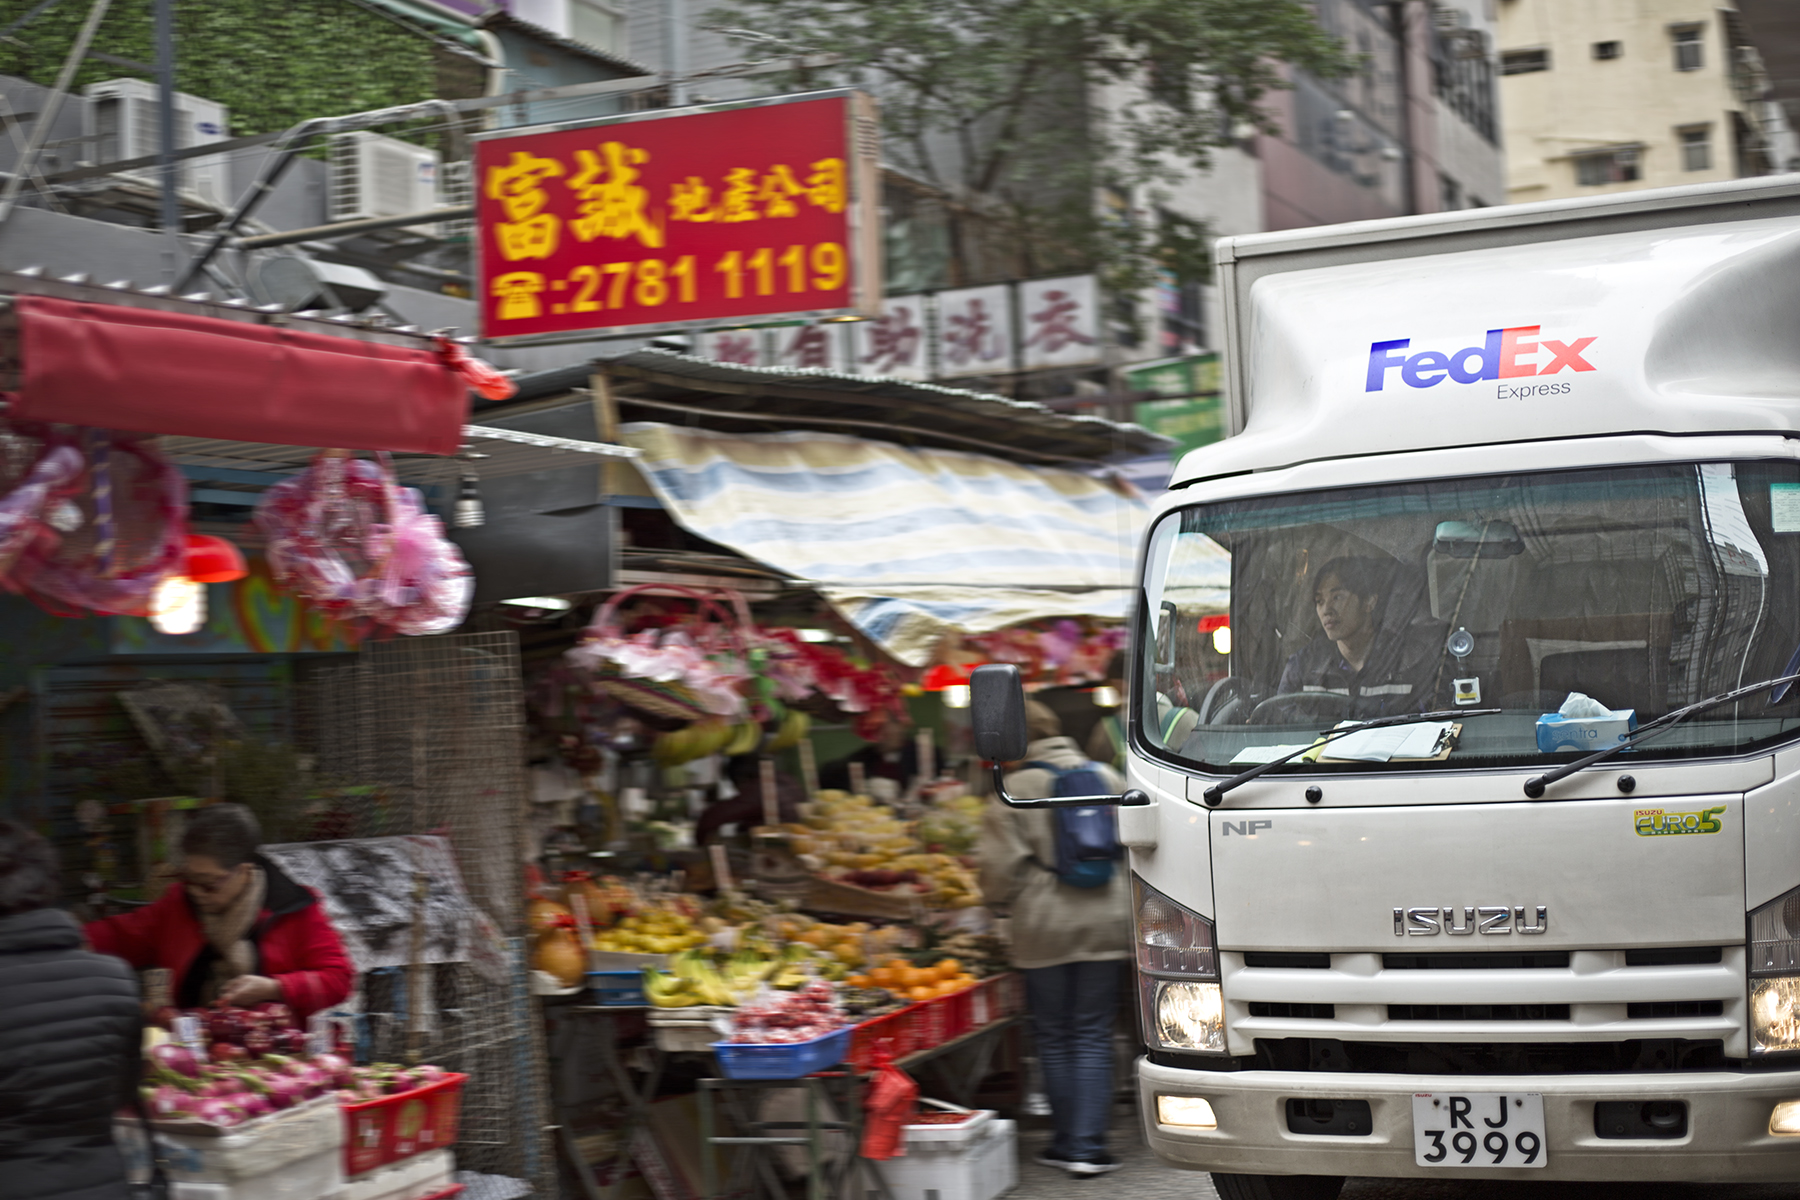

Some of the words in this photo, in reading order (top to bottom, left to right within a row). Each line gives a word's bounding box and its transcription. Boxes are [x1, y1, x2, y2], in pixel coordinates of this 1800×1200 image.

[484, 141, 666, 261] 富誠
[667, 157, 847, 223] 地產公司
[715, 241, 847, 298] 1119
[1365, 324, 1598, 393] FedEx
[1497, 382, 1571, 400] Express
[1222, 820, 1272, 836] NP
[1393, 905, 1548, 936] ISUZU
[1423, 1130, 1541, 1164] 3999
